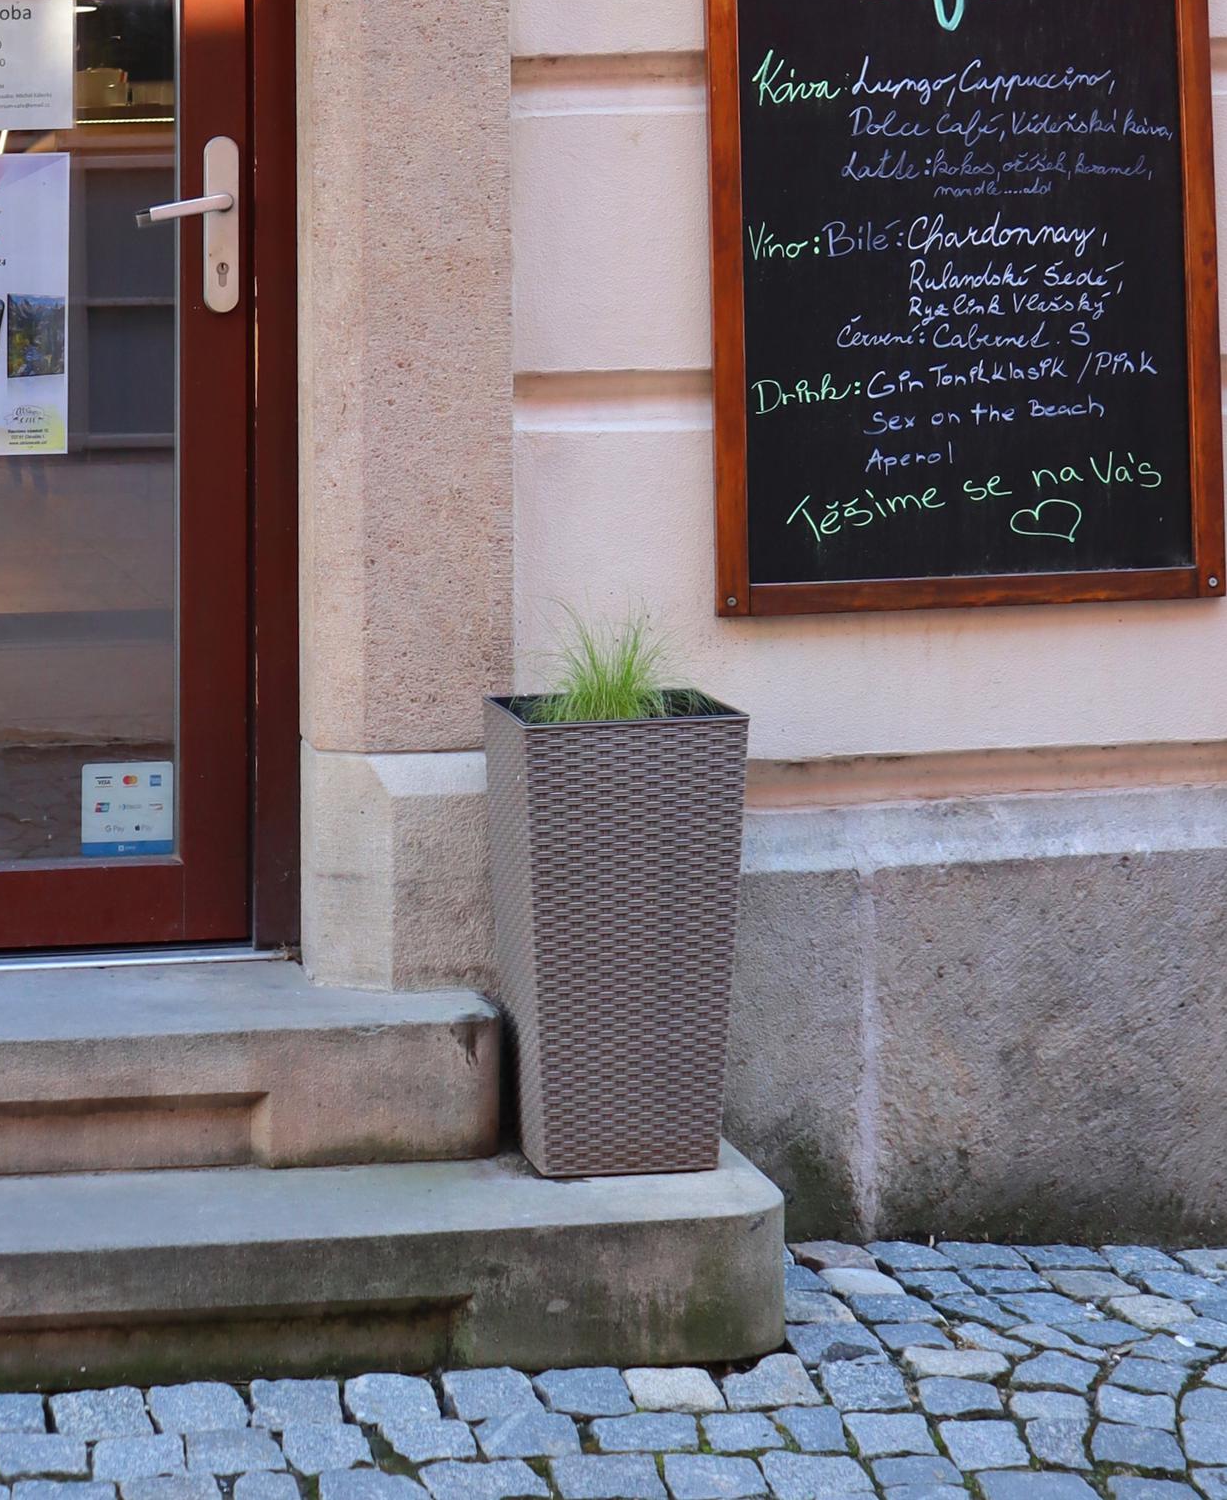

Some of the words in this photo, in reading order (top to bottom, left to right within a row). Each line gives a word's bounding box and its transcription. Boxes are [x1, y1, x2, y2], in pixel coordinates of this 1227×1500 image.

[1069, 322, 1091, 346] S
[867, 370, 924, 399] Gin
[863, 411, 916, 435] Sex
[931, 412, 961, 426] on
[971, 402, 1015, 425] the
[1028, 395, 1104, 418] Beach
[865, 441, 954, 475] Aperol
[962, 475, 1012, 501] se
[1031, 466, 1084, 488] na
